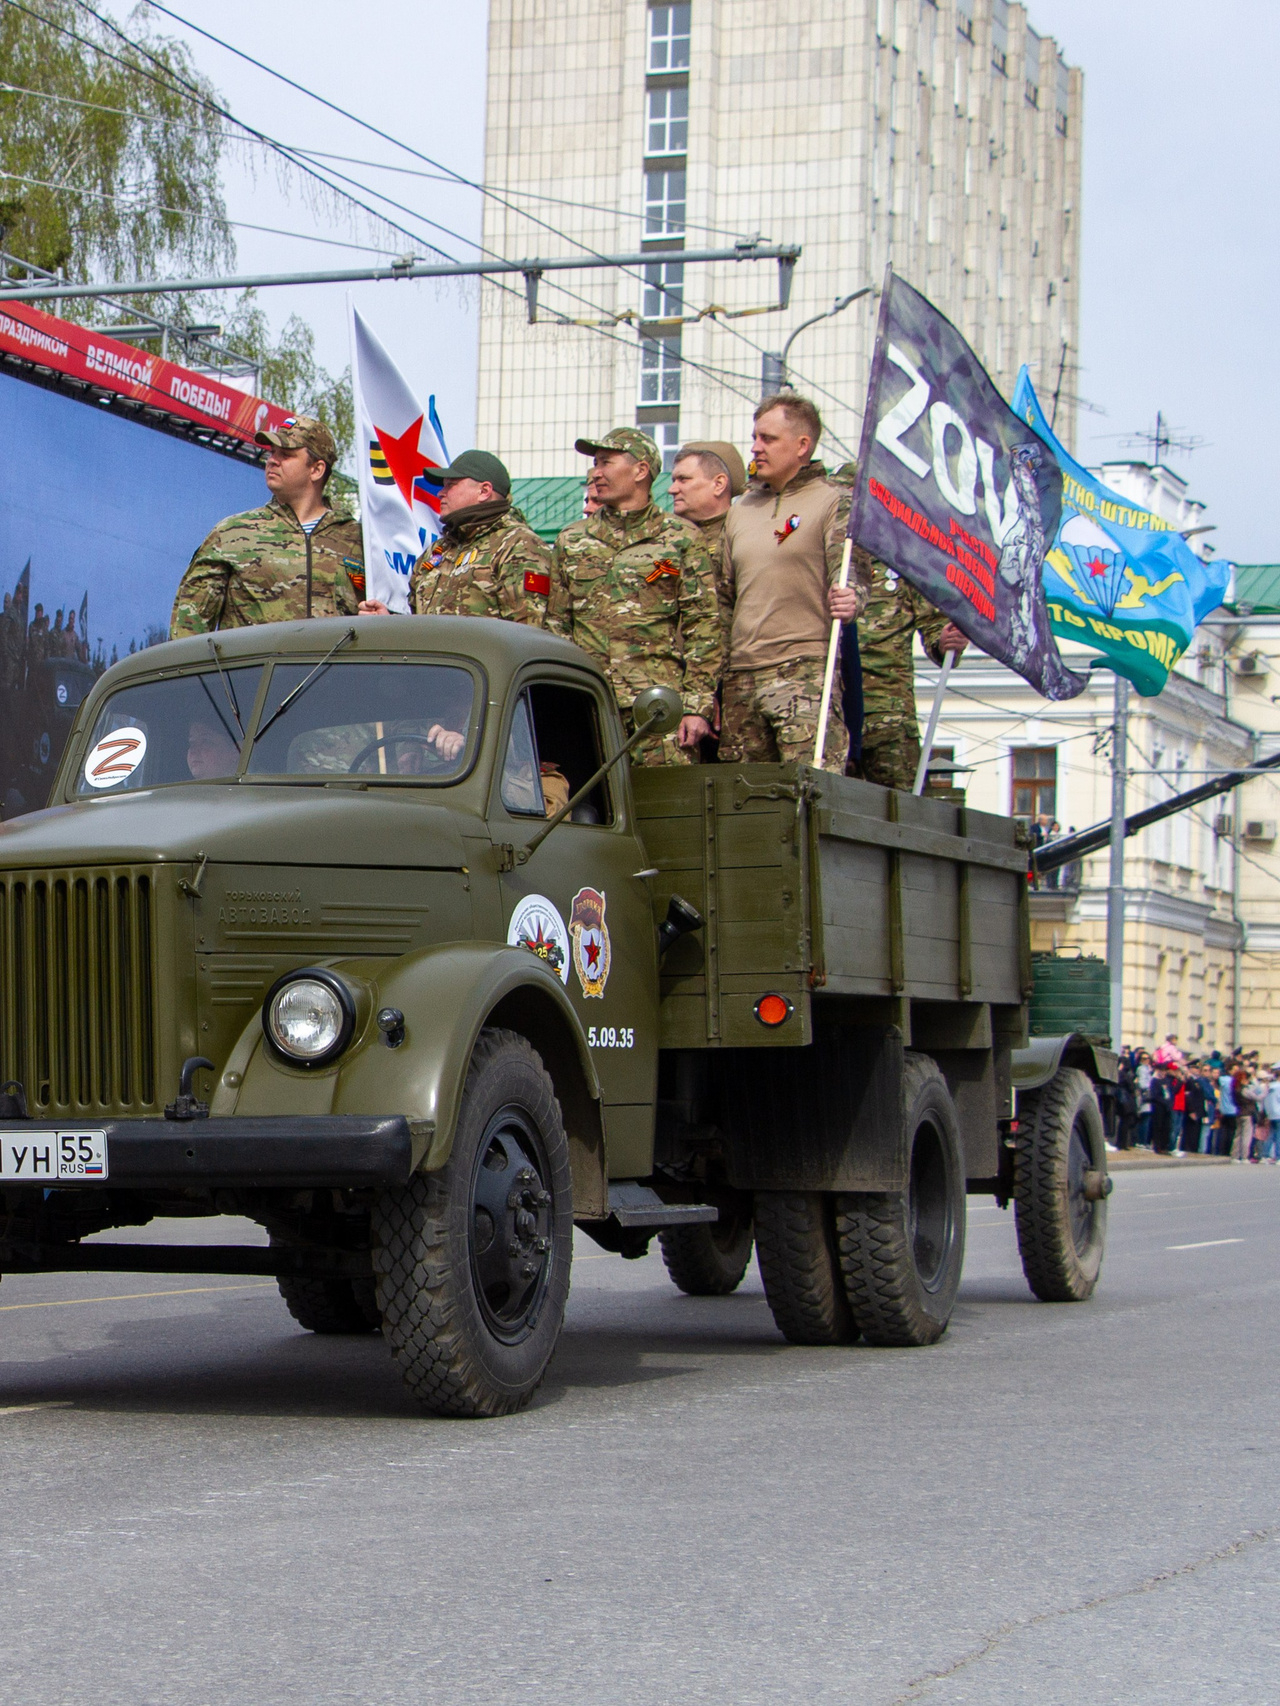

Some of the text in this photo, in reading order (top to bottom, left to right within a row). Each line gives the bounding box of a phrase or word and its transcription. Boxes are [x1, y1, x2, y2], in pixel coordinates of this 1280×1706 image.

[85, 344, 153, 390] ВЕЛИКОЙ
[170, 376, 232, 420] ПОБЕДЫ!
[875, 343, 1021, 549] ZOV
[869, 477, 955, 557] СПЕЦИАЛЬНОЙ
[91, 738, 141, 776] Z
[588, 1026, 634, 1048] 5.09.35
[61, 1136, 93, 1162] 55
[60, 1164, 84, 1174] RUS
